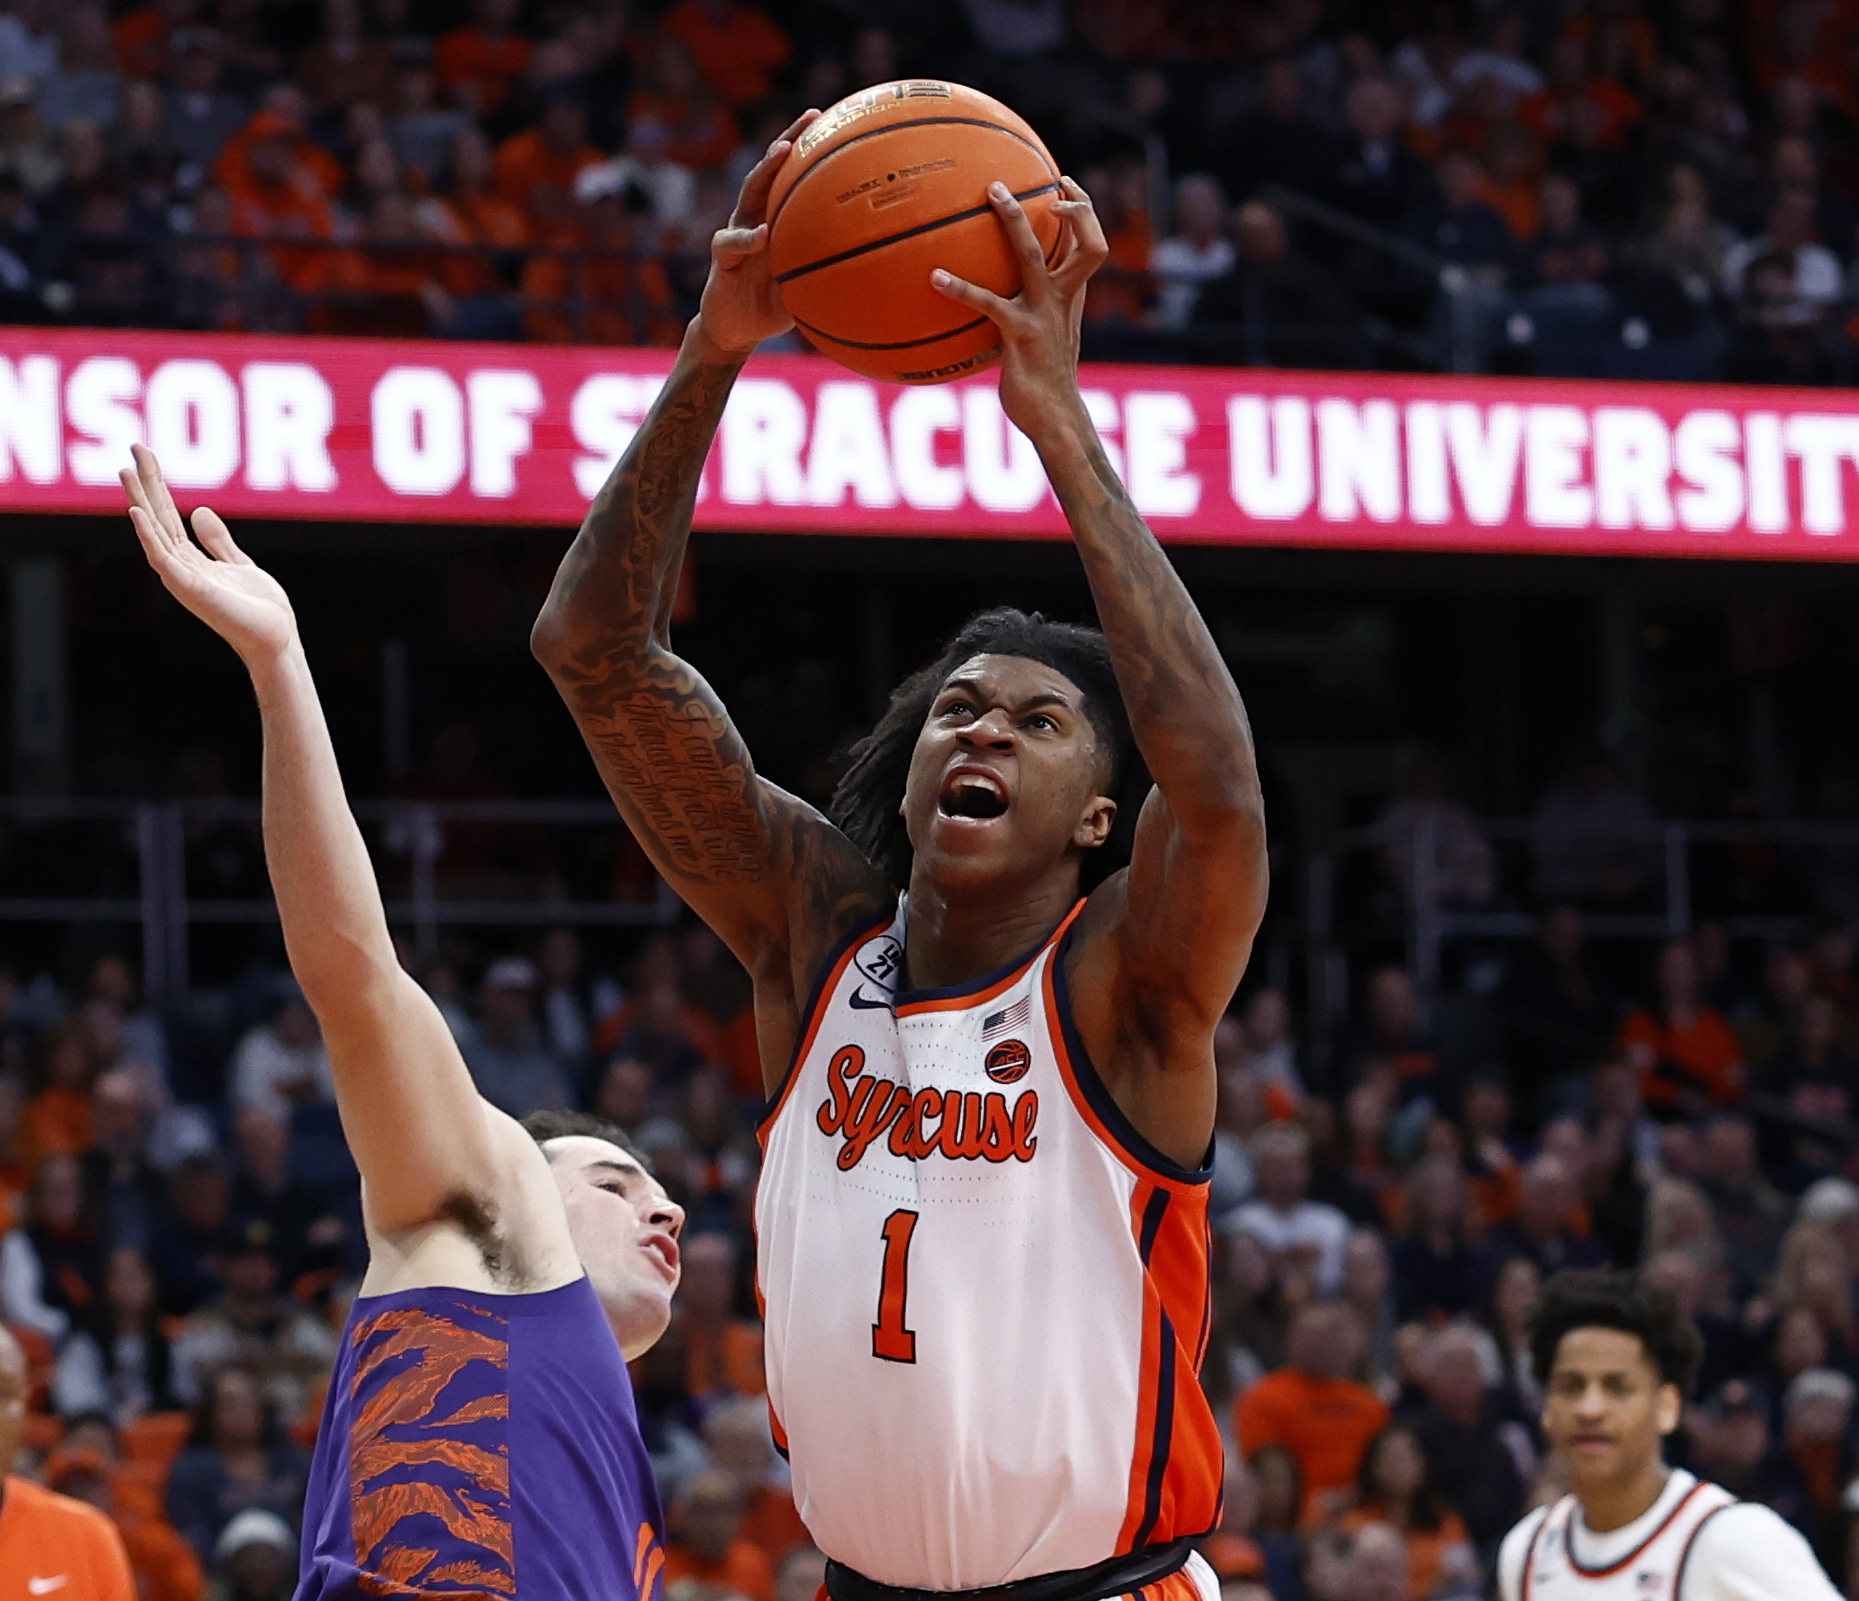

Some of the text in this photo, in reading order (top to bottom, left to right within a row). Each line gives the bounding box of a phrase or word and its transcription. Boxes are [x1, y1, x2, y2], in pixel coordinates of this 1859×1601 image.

[0, 354, 1859, 536] NSOR OF SRACUE UNIVERSIT
[866, 955, 894, 980] 21
[816, 1044, 1038, 1171] Syracuse
[872, 1208, 919, 1364] 1
